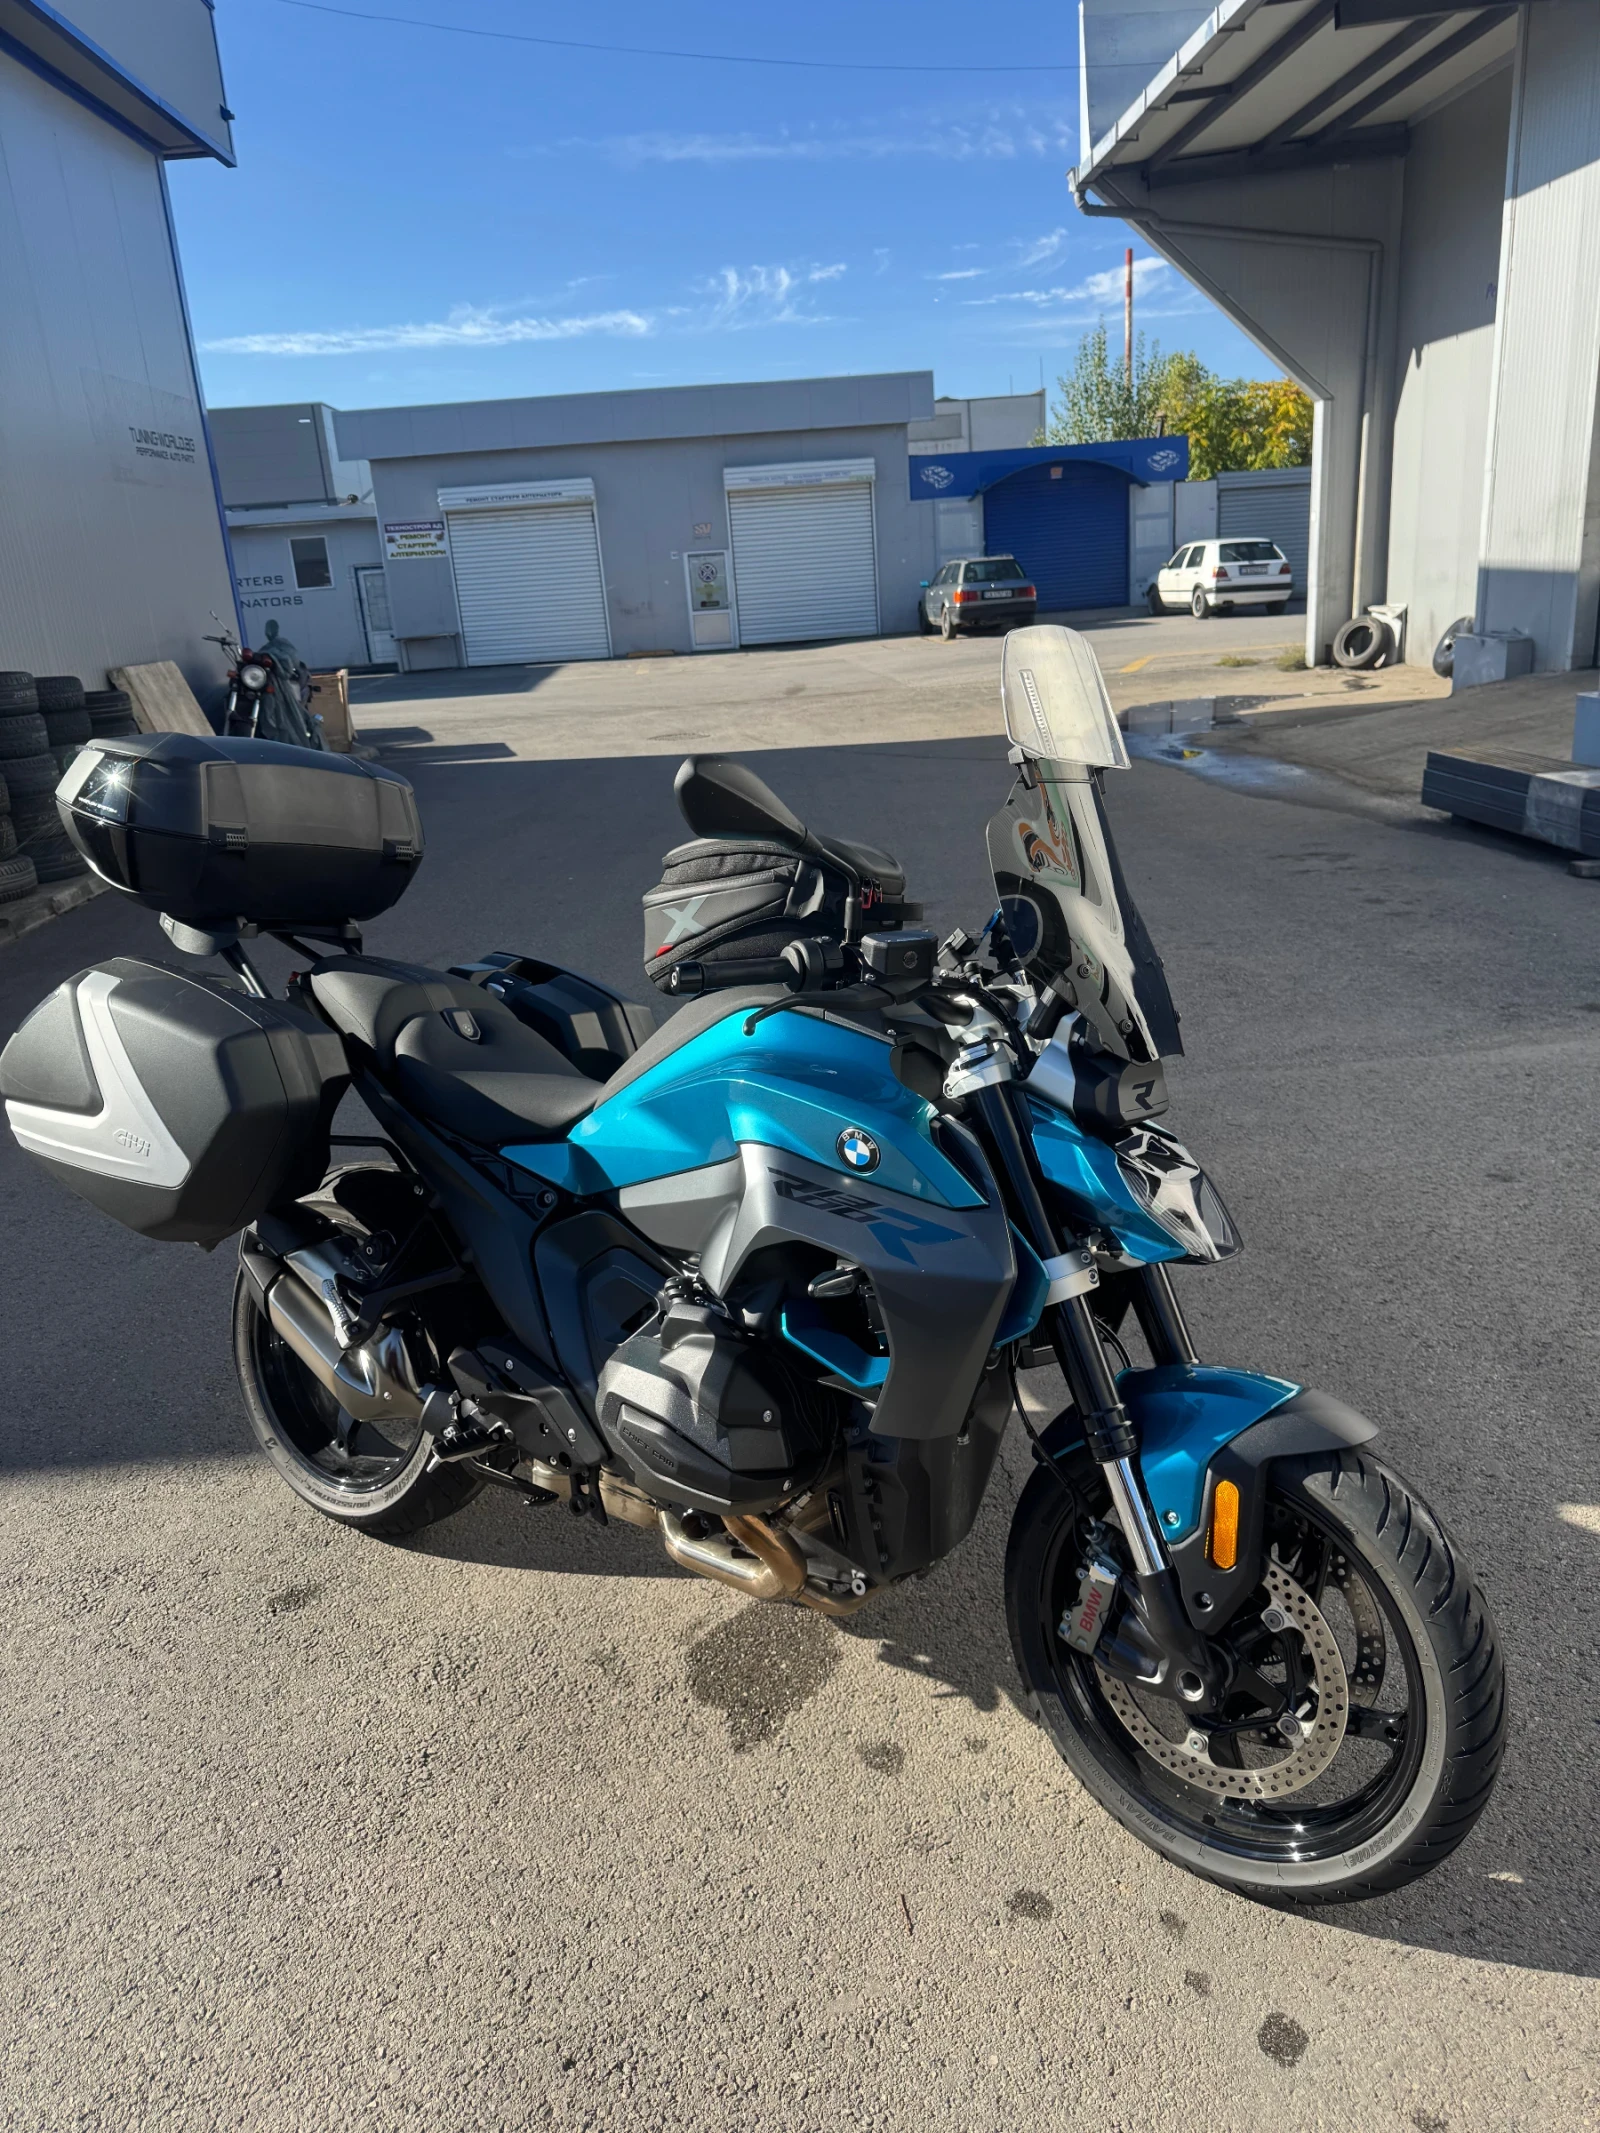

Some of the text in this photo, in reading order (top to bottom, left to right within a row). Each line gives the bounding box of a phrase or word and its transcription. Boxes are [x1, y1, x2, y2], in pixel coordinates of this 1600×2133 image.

[390, 550, 446, 558] АЛТЕРНАТОРИ
[397, 542, 437, 550] СТАРТЕРИ
[384, 1445, 427, 1503] BRIDGESTONE
[1079, 1586, 1103, 1633] BMW
[1350, 1806, 1415, 1868] BRIDGESTONE
